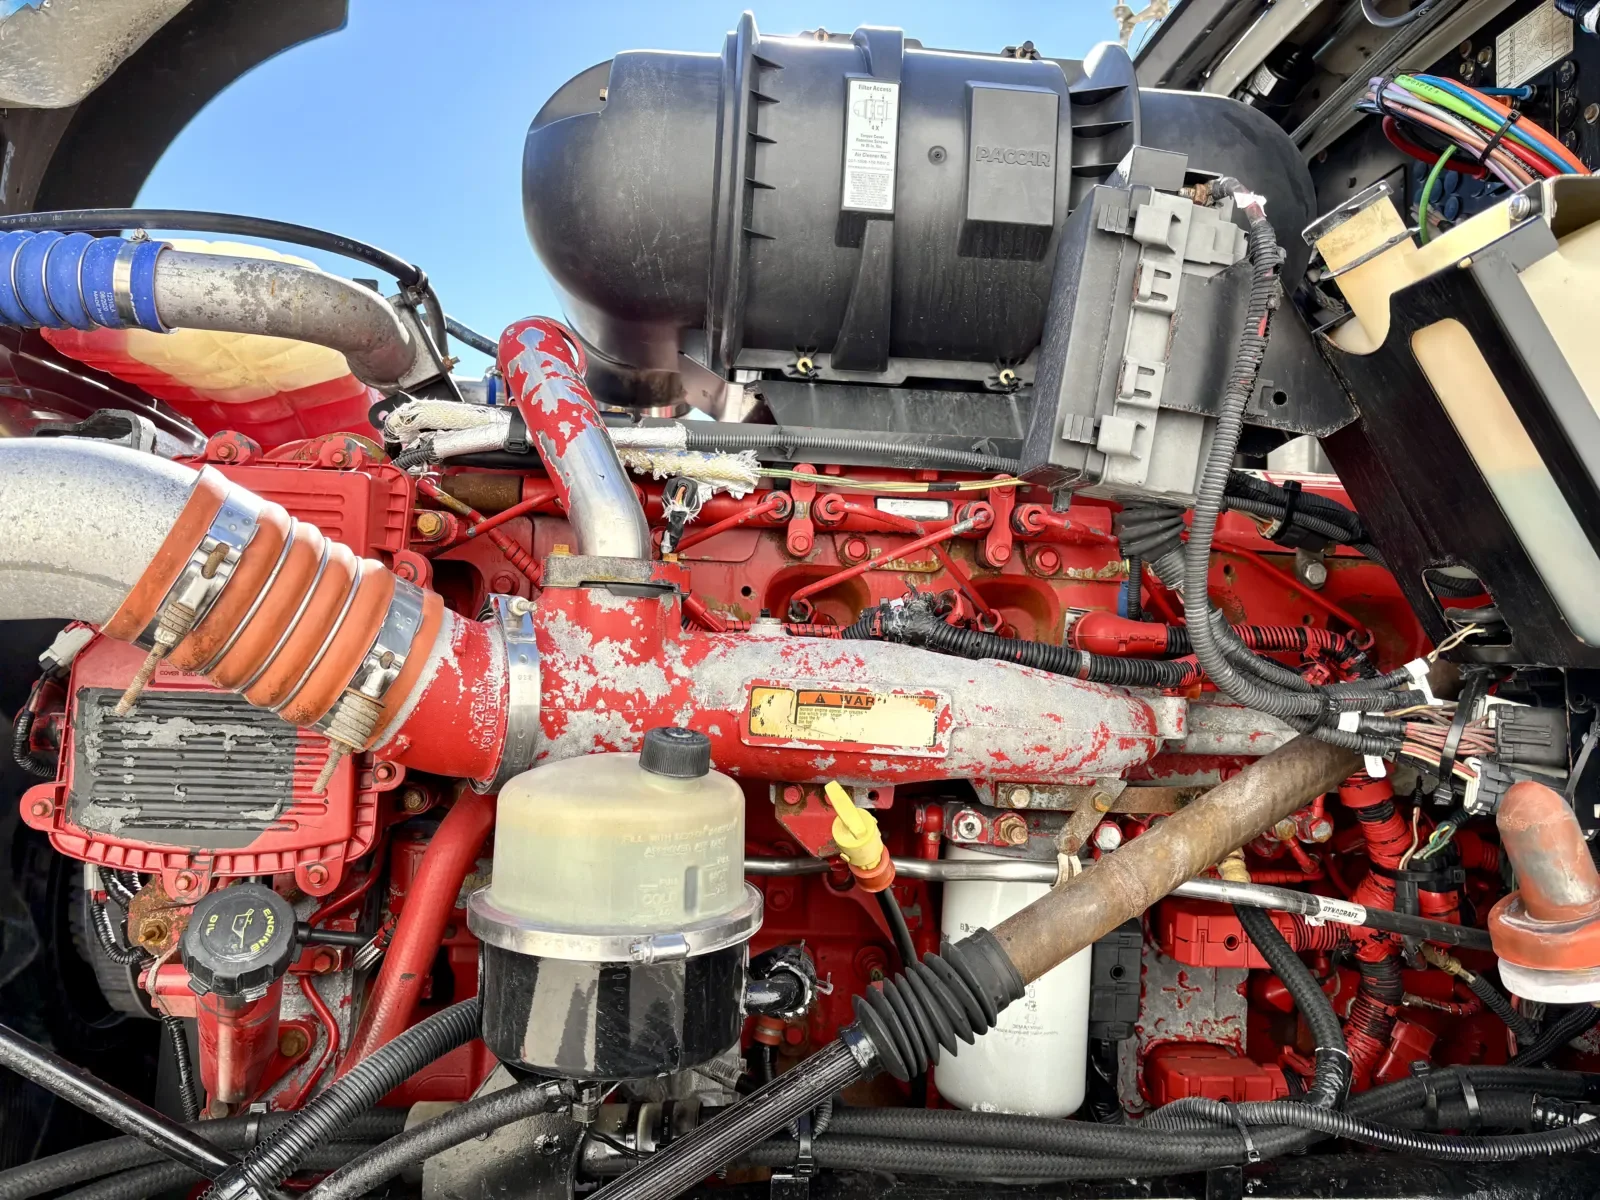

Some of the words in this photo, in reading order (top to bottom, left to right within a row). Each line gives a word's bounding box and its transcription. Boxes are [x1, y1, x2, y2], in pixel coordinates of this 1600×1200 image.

[858, 83, 872, 91] Filter
[873, 85, 892, 93] Access
[976, 146, 1051, 168] PACCAR
[1322, 905, 1358, 919] DYNACRAFT
[205, 914, 219, 937] OIL
[250, 907, 275, 953] ENGINE
